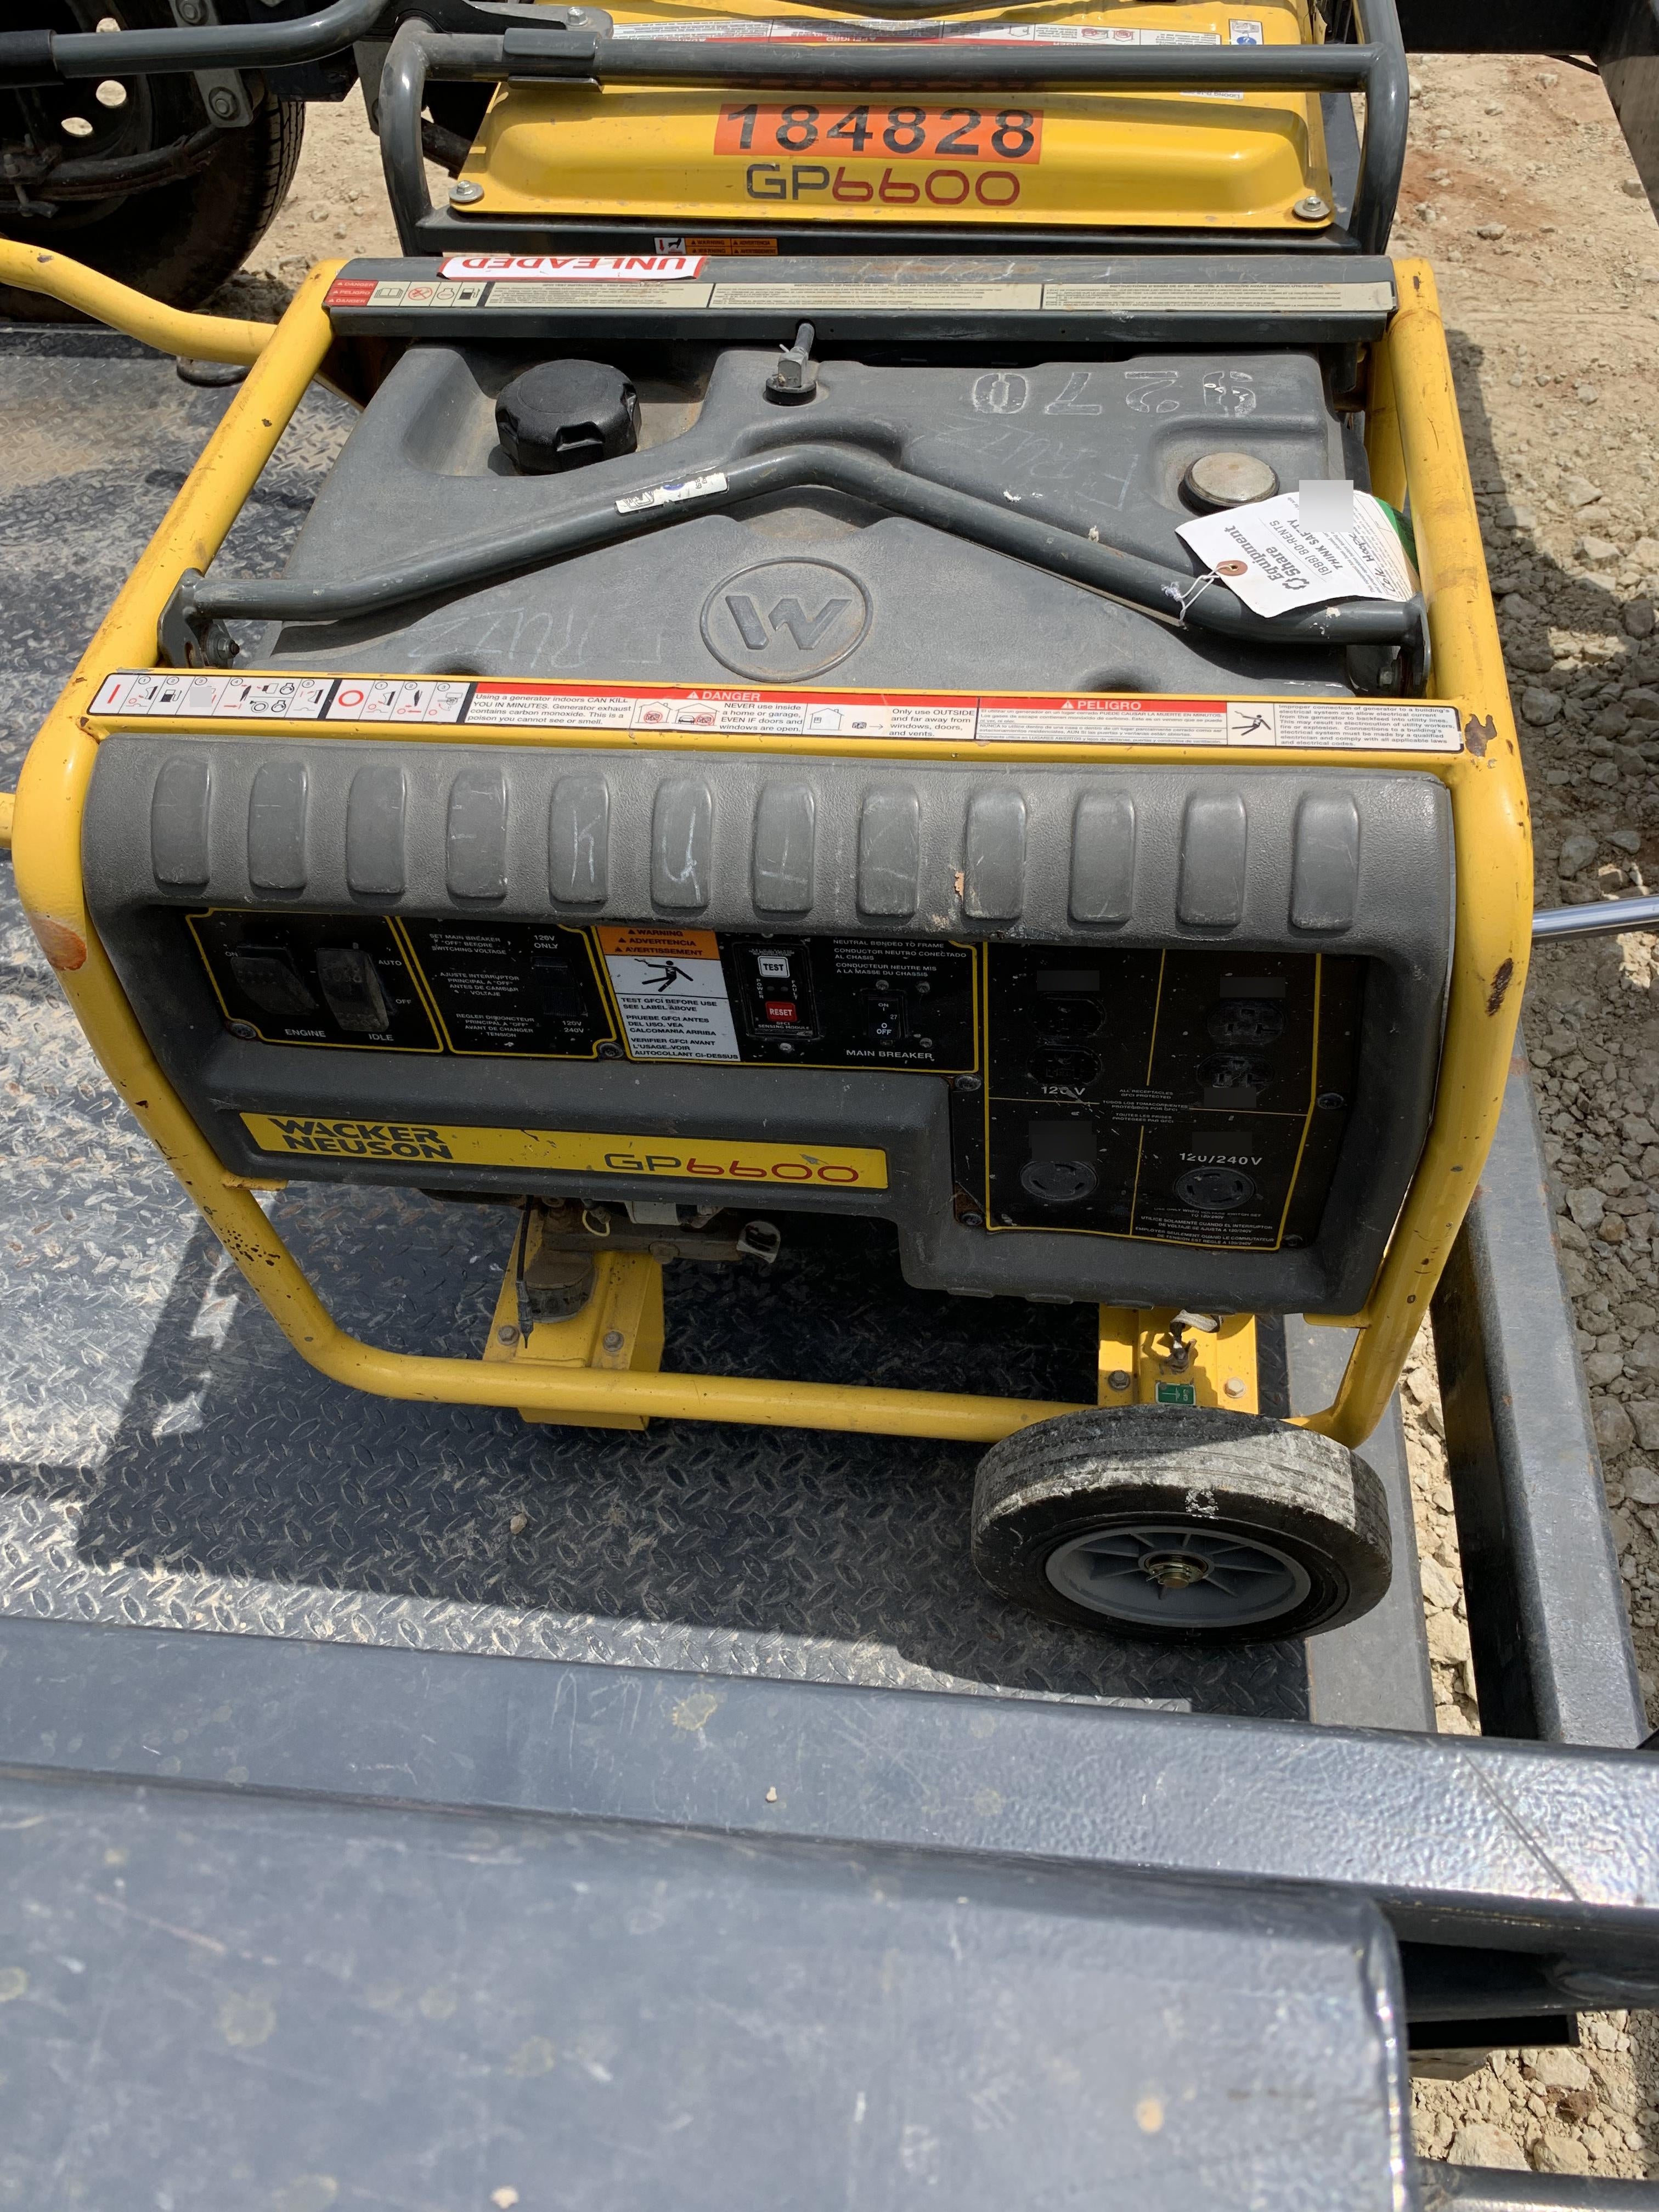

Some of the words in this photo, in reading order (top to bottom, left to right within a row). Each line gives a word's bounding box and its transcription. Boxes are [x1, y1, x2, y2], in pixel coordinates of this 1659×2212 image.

[727, 104, 1034, 158] 184828
[746, 164, 1020, 206] GP6600
[461, 257, 686, 270] UNLEADED
[1269, 520, 1309, 555] 80-RENTS
[1287, 518, 1319, 545] SAFTY
[1223, 525, 1285, 582] Equipment
[1266, 546, 1301, 577] Share
[1305, 554, 1333, 575] (888)
[1315, 545, 1344, 571] THINK
[702, 692, 760, 702] DANGER
[1077, 701, 1141, 710] PELIGRO
[629, 938, 696, 946] ADVERTENCIA
[285, 1029, 326, 1037] ENGINE
[272, 1118, 442, 1144] WACKER
[284, 1134, 453, 1160] NEUSON
[1178, 1153, 1262, 1166] 120/240V
[605, 1153, 859, 1183] GP6600
